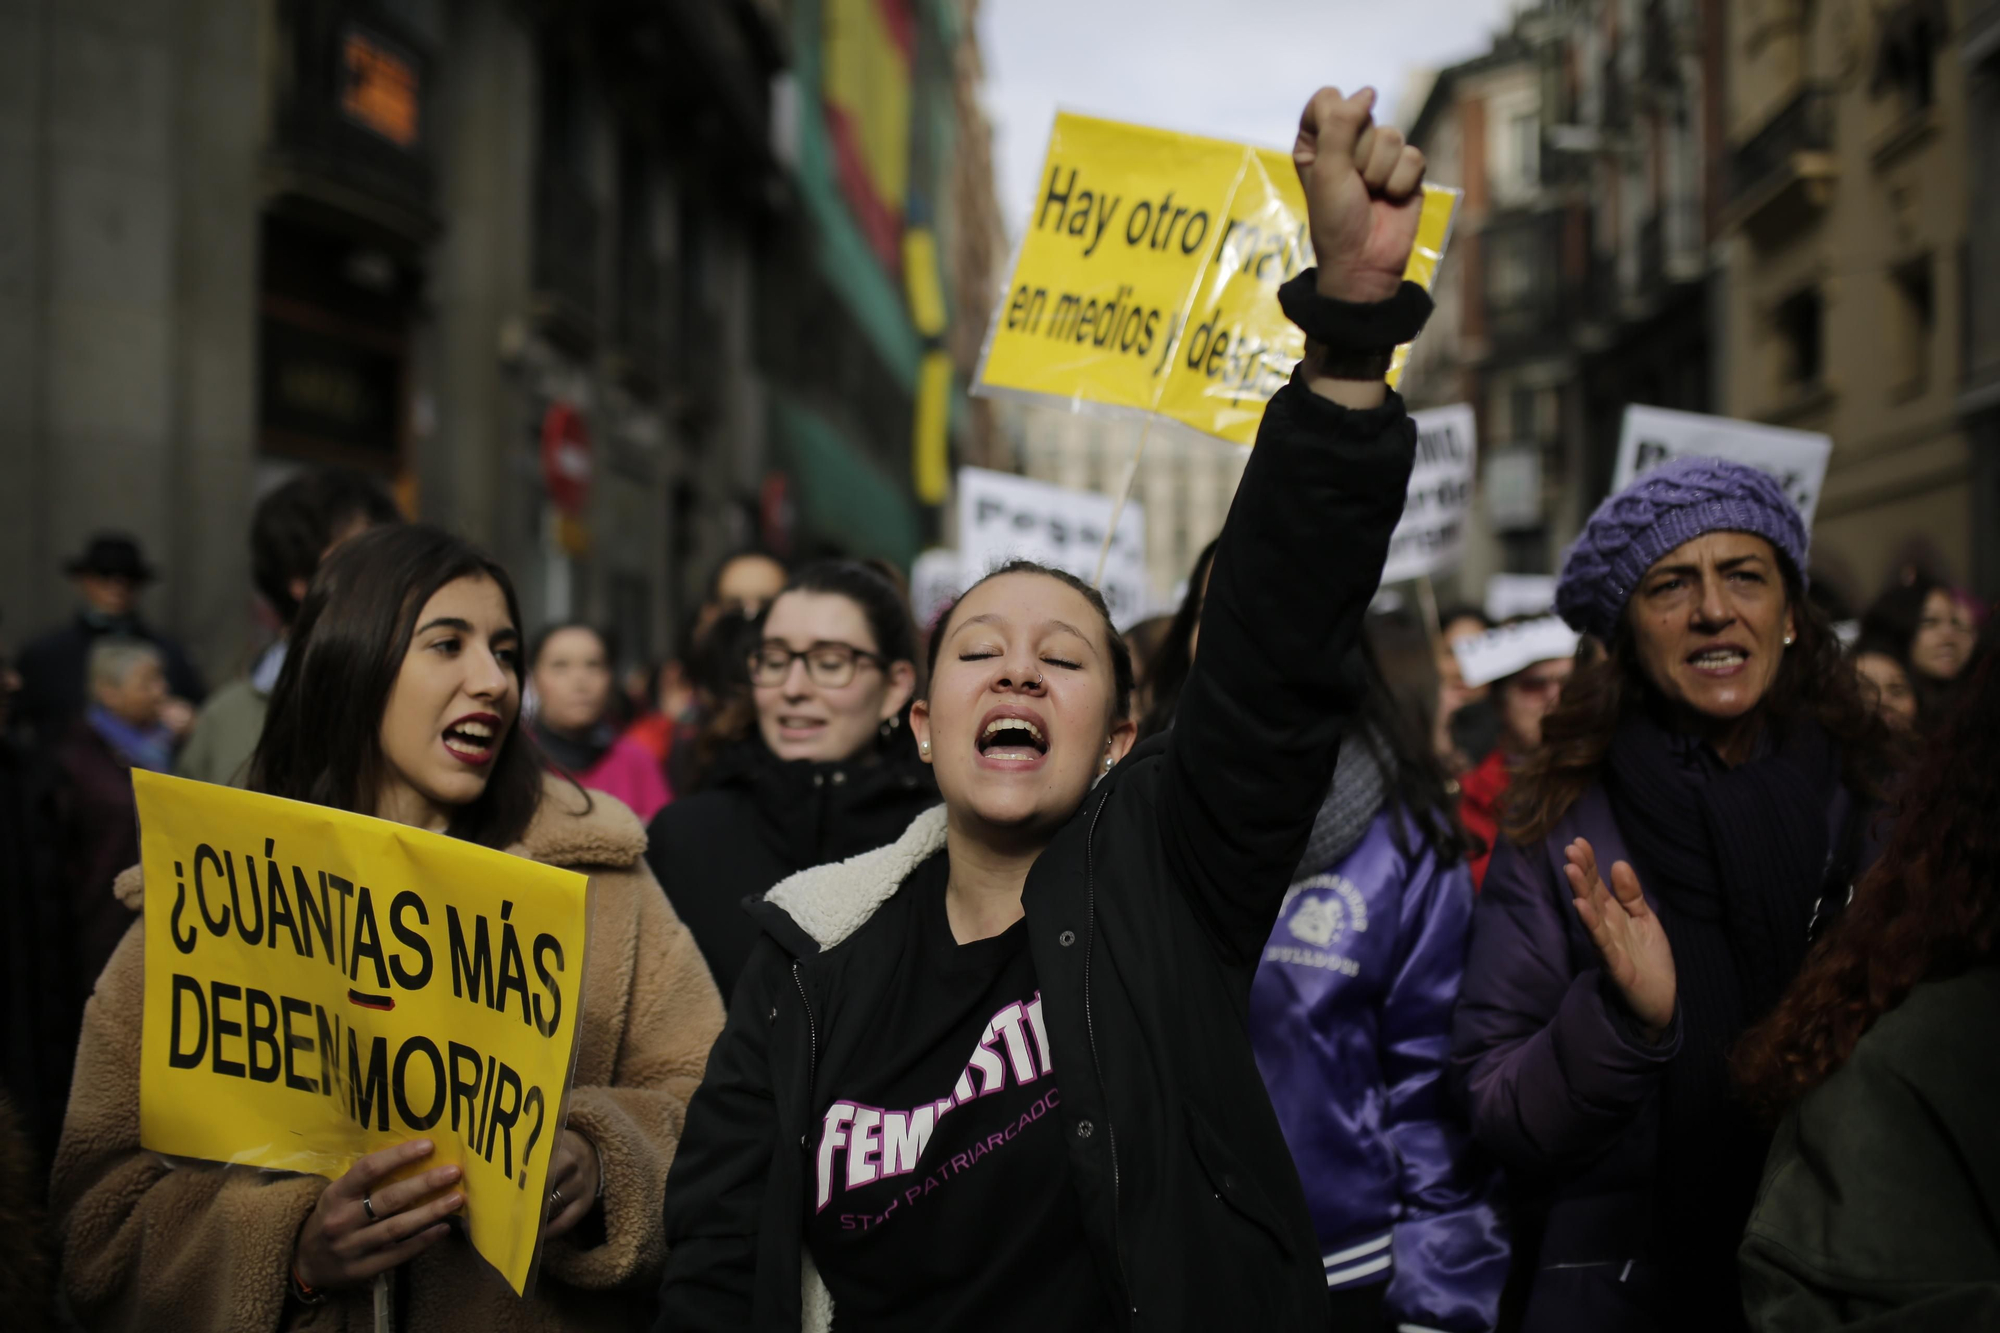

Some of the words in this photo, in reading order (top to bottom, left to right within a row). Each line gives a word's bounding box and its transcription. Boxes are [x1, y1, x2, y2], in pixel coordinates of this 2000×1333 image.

[1037, 165, 1121, 258] Hay
[1126, 189, 1209, 256] otro
[1007, 284, 1047, 336] en
[1047, 284, 1161, 356] medios
[170, 838, 434, 991] ¿CUÁNTAS
[446, 900, 565, 1039] MÁS
[169, 973, 346, 1108] DEBEN
[348, 1026, 544, 1191] MORIR?
